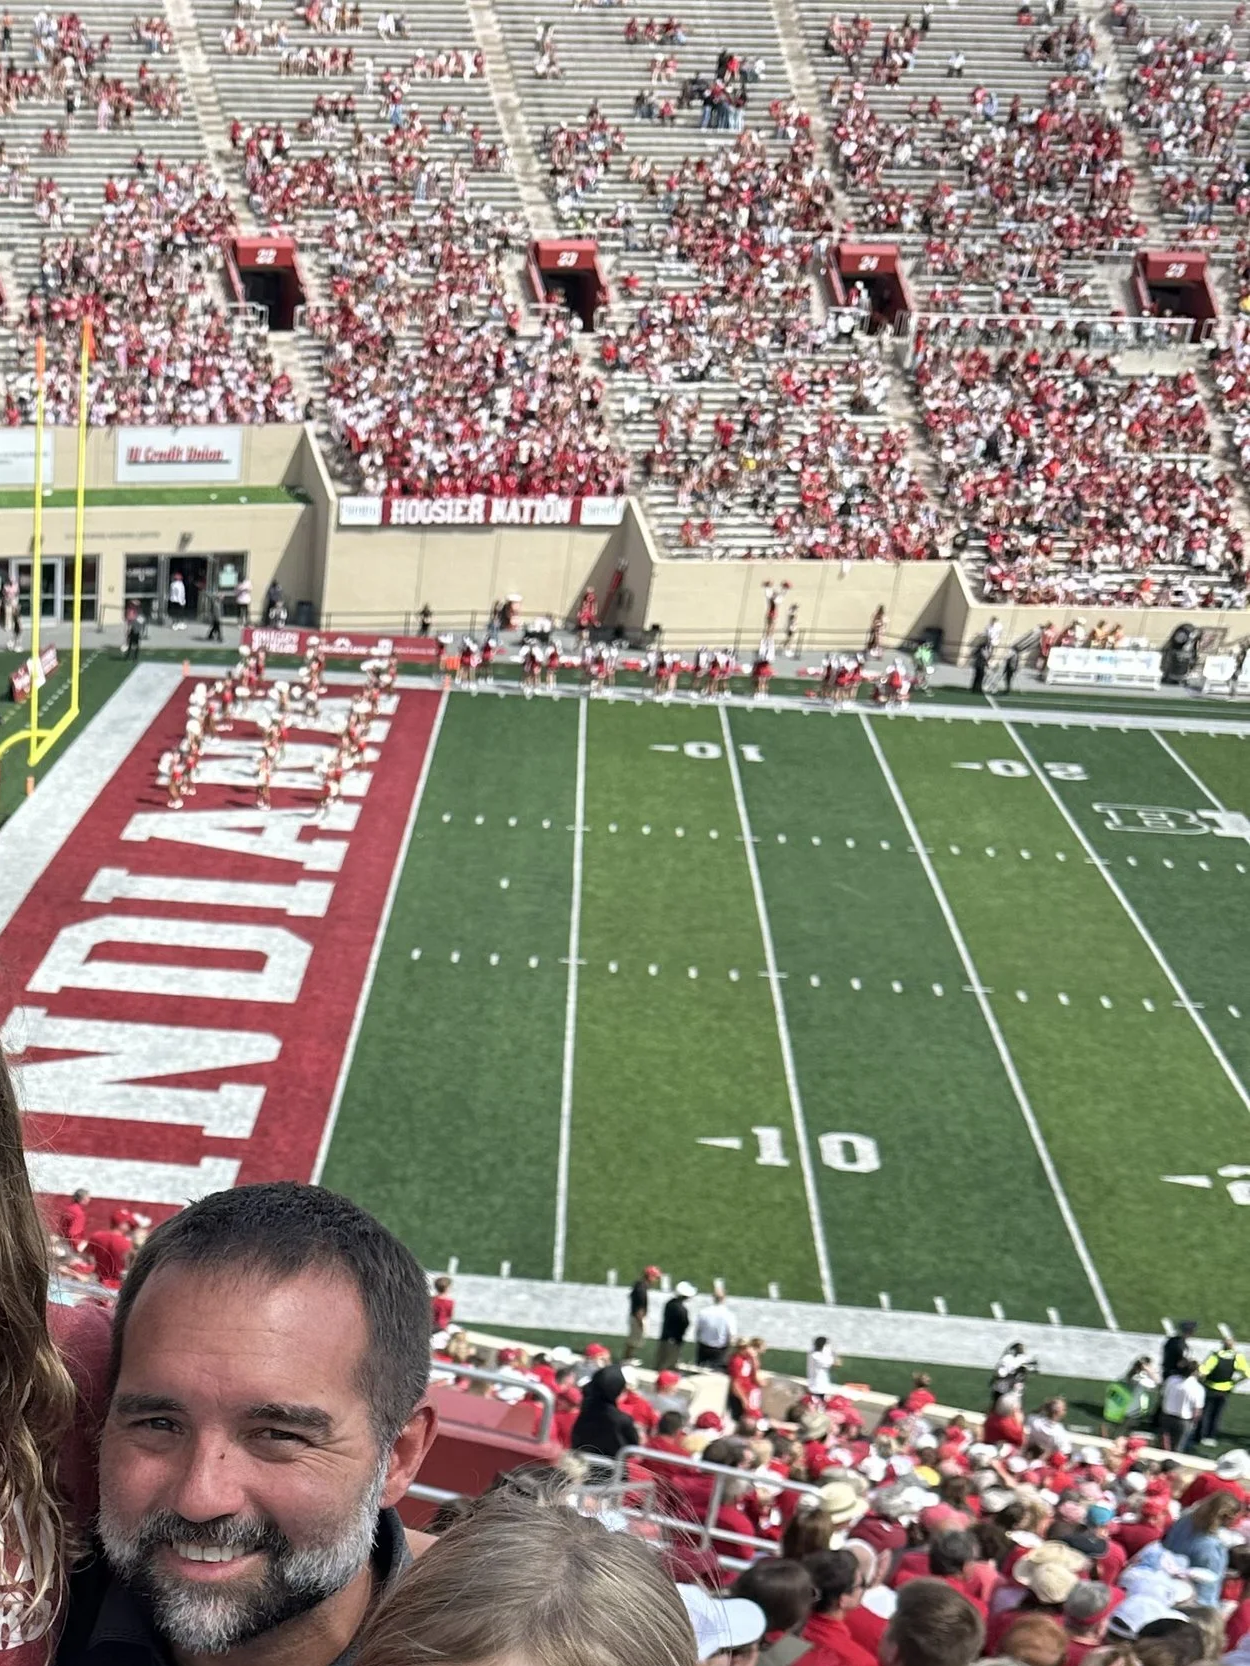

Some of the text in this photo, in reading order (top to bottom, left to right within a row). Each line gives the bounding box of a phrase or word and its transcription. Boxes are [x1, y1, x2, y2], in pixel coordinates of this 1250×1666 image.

[390, 498, 486, 525] HOOSIER
[489, 498, 573, 525] NATION
[751, 1125, 881, 1174] 10
